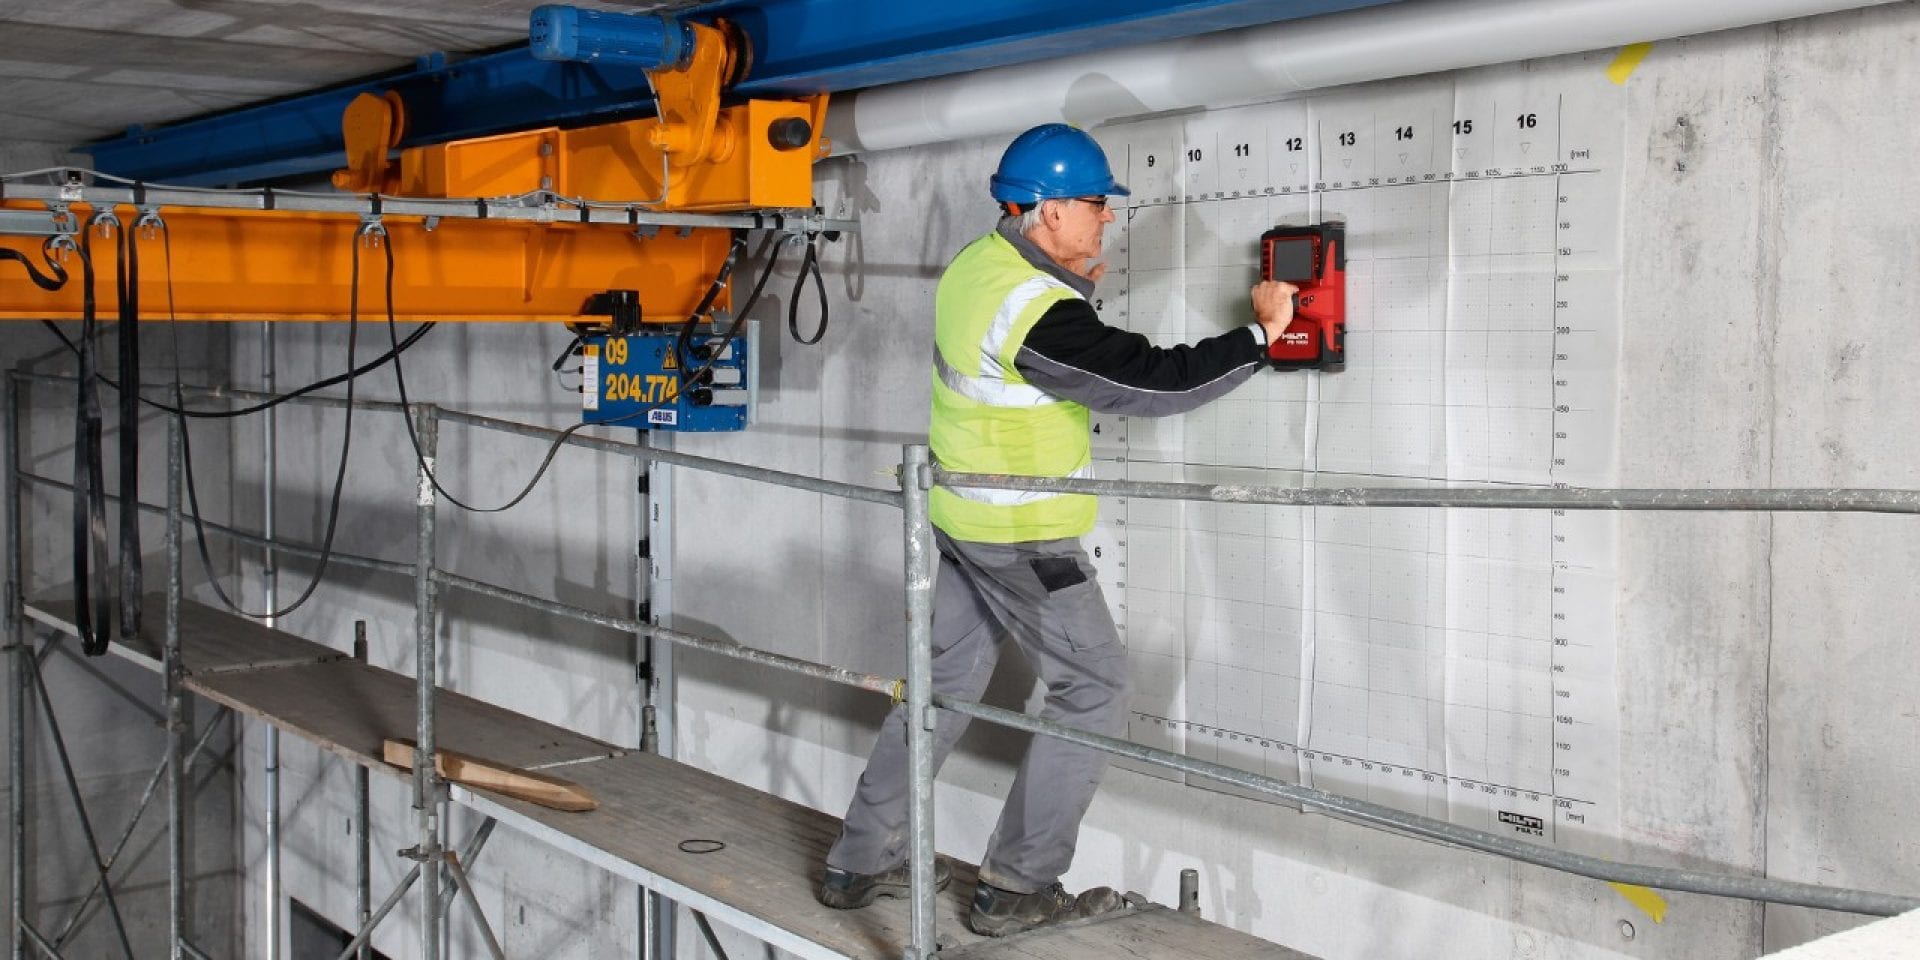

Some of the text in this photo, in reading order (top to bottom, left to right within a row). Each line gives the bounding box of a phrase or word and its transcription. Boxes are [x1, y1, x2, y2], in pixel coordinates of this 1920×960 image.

[1147, 113, 1537, 167] 9 10 11 12 13 14 15 16
[1096, 299, 1103, 311] 2
[605, 337, 628, 365] 09
[605, 373, 678, 404] 204.774
[651, 410, 673, 422] ABUS
[1093, 423, 1100, 435] 4
[1094, 546, 1101, 558] 6
